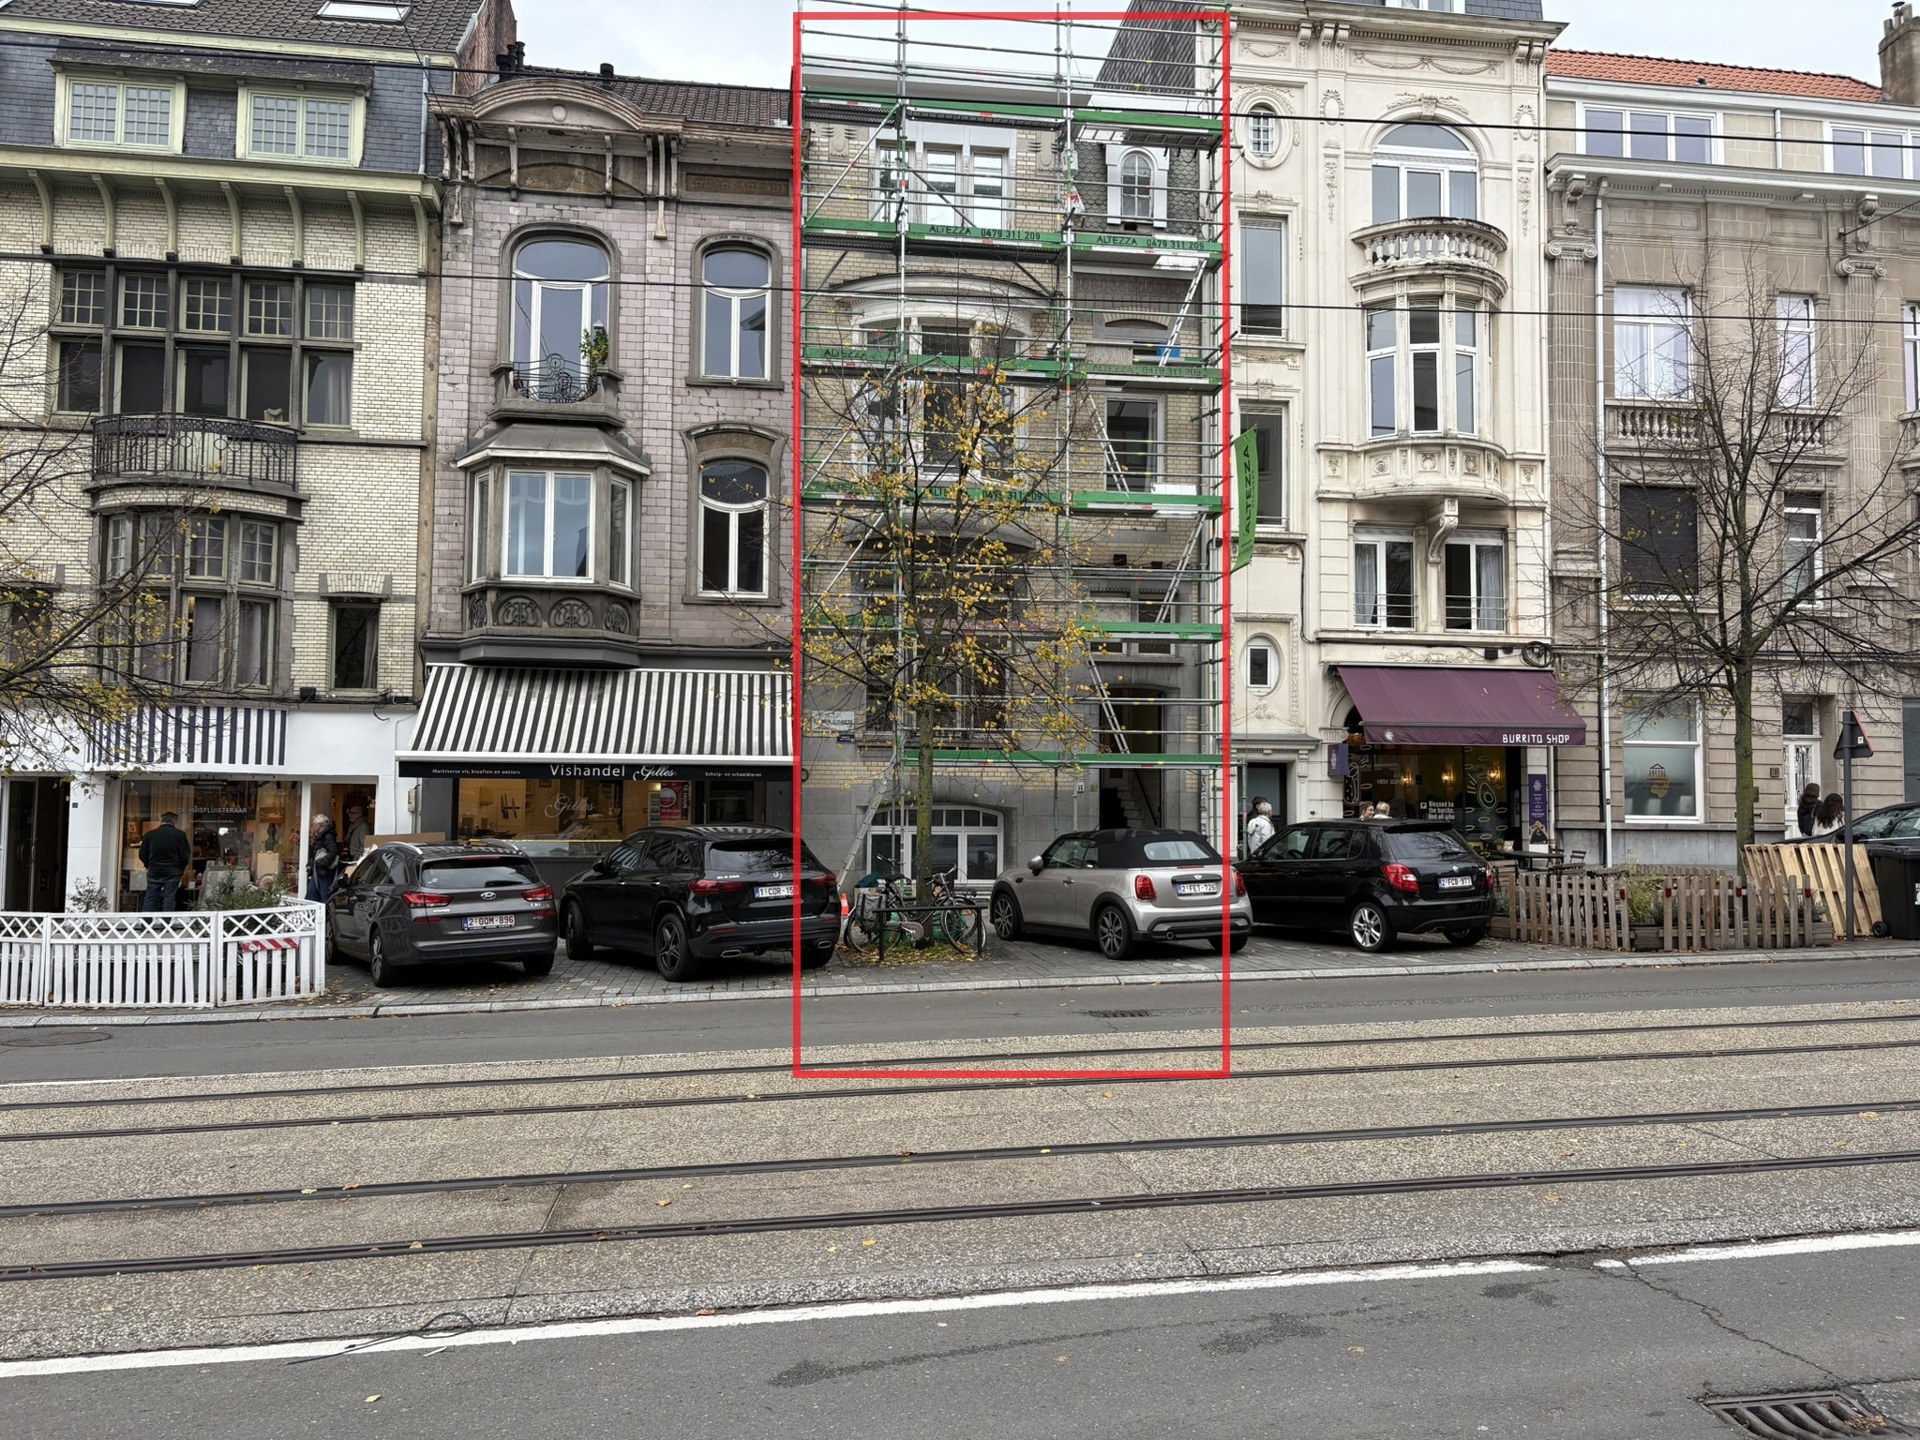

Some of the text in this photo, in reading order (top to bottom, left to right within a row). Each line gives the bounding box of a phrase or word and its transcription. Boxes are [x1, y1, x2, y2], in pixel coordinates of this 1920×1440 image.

[929, 225, 1041, 240] ALTEZZA 0479 311 209
[1096, 236, 1204, 250] ALTEZZA 0479 311 209
[1243, 444, 1251, 535] ALTEZZA
[1502, 733, 1570, 744] BURRITO SHOP
[550, 764, 677, 780] Vishandel Gilles
